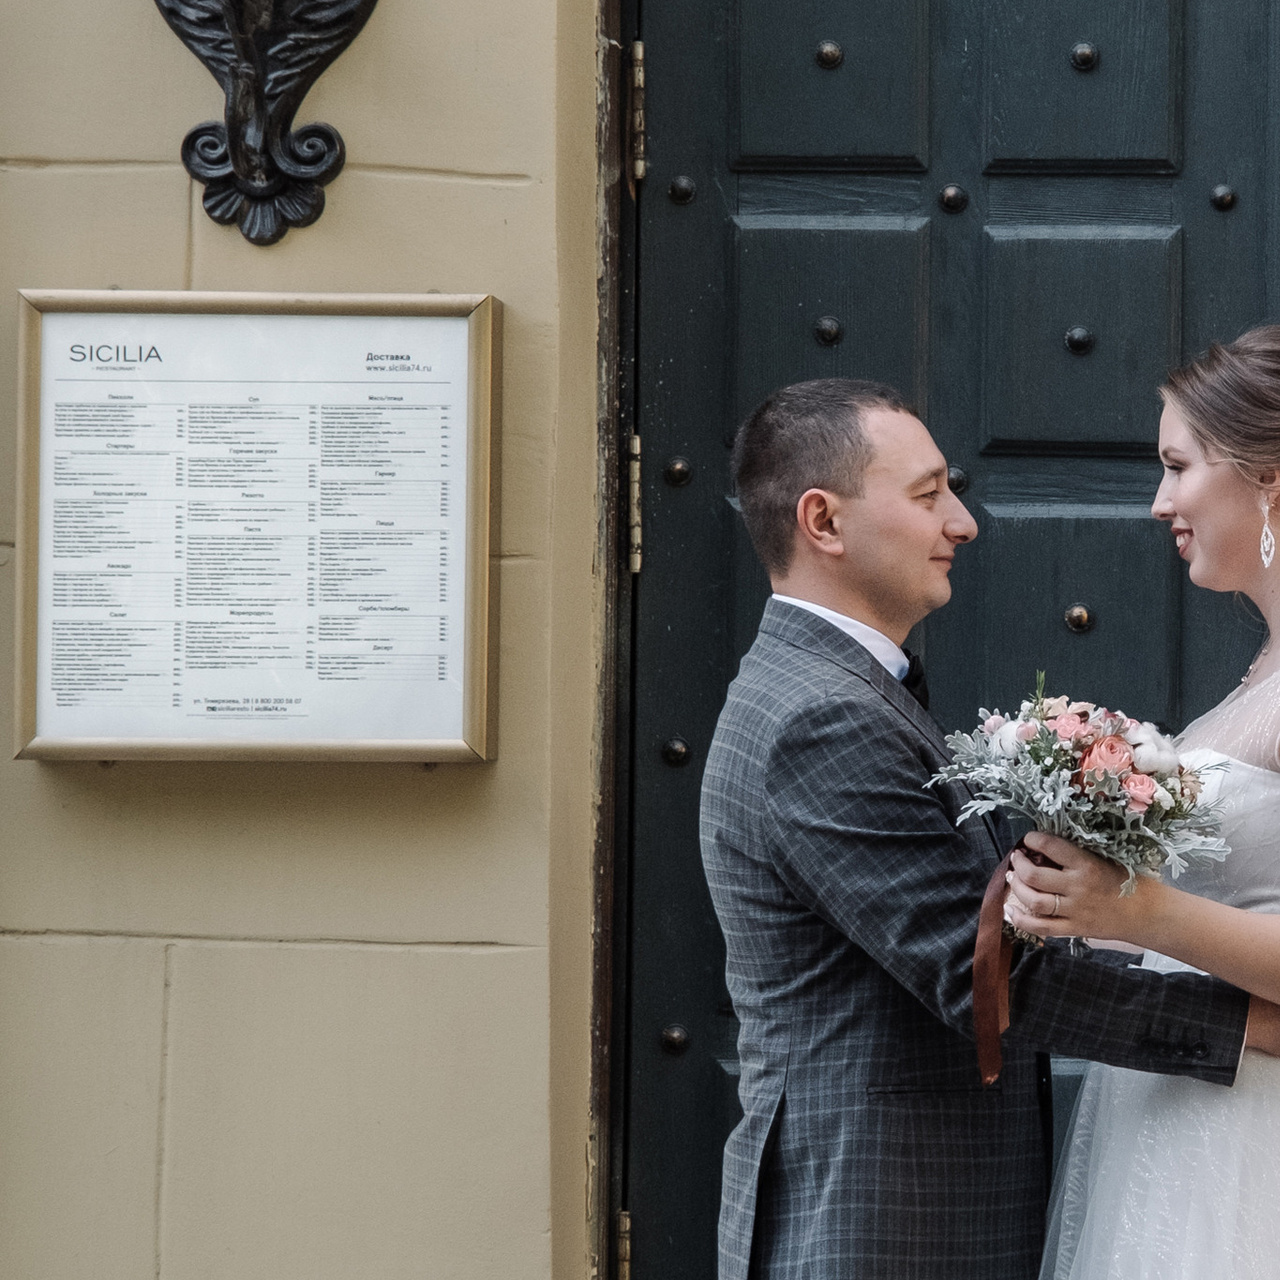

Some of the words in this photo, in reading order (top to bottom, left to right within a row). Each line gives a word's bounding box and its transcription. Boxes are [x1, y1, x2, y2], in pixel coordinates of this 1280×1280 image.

[69, 344, 163, 363] SICILIA
[366, 352, 411, 362] Доставка
[366, 364, 432, 372] www.sicilia74.ru
